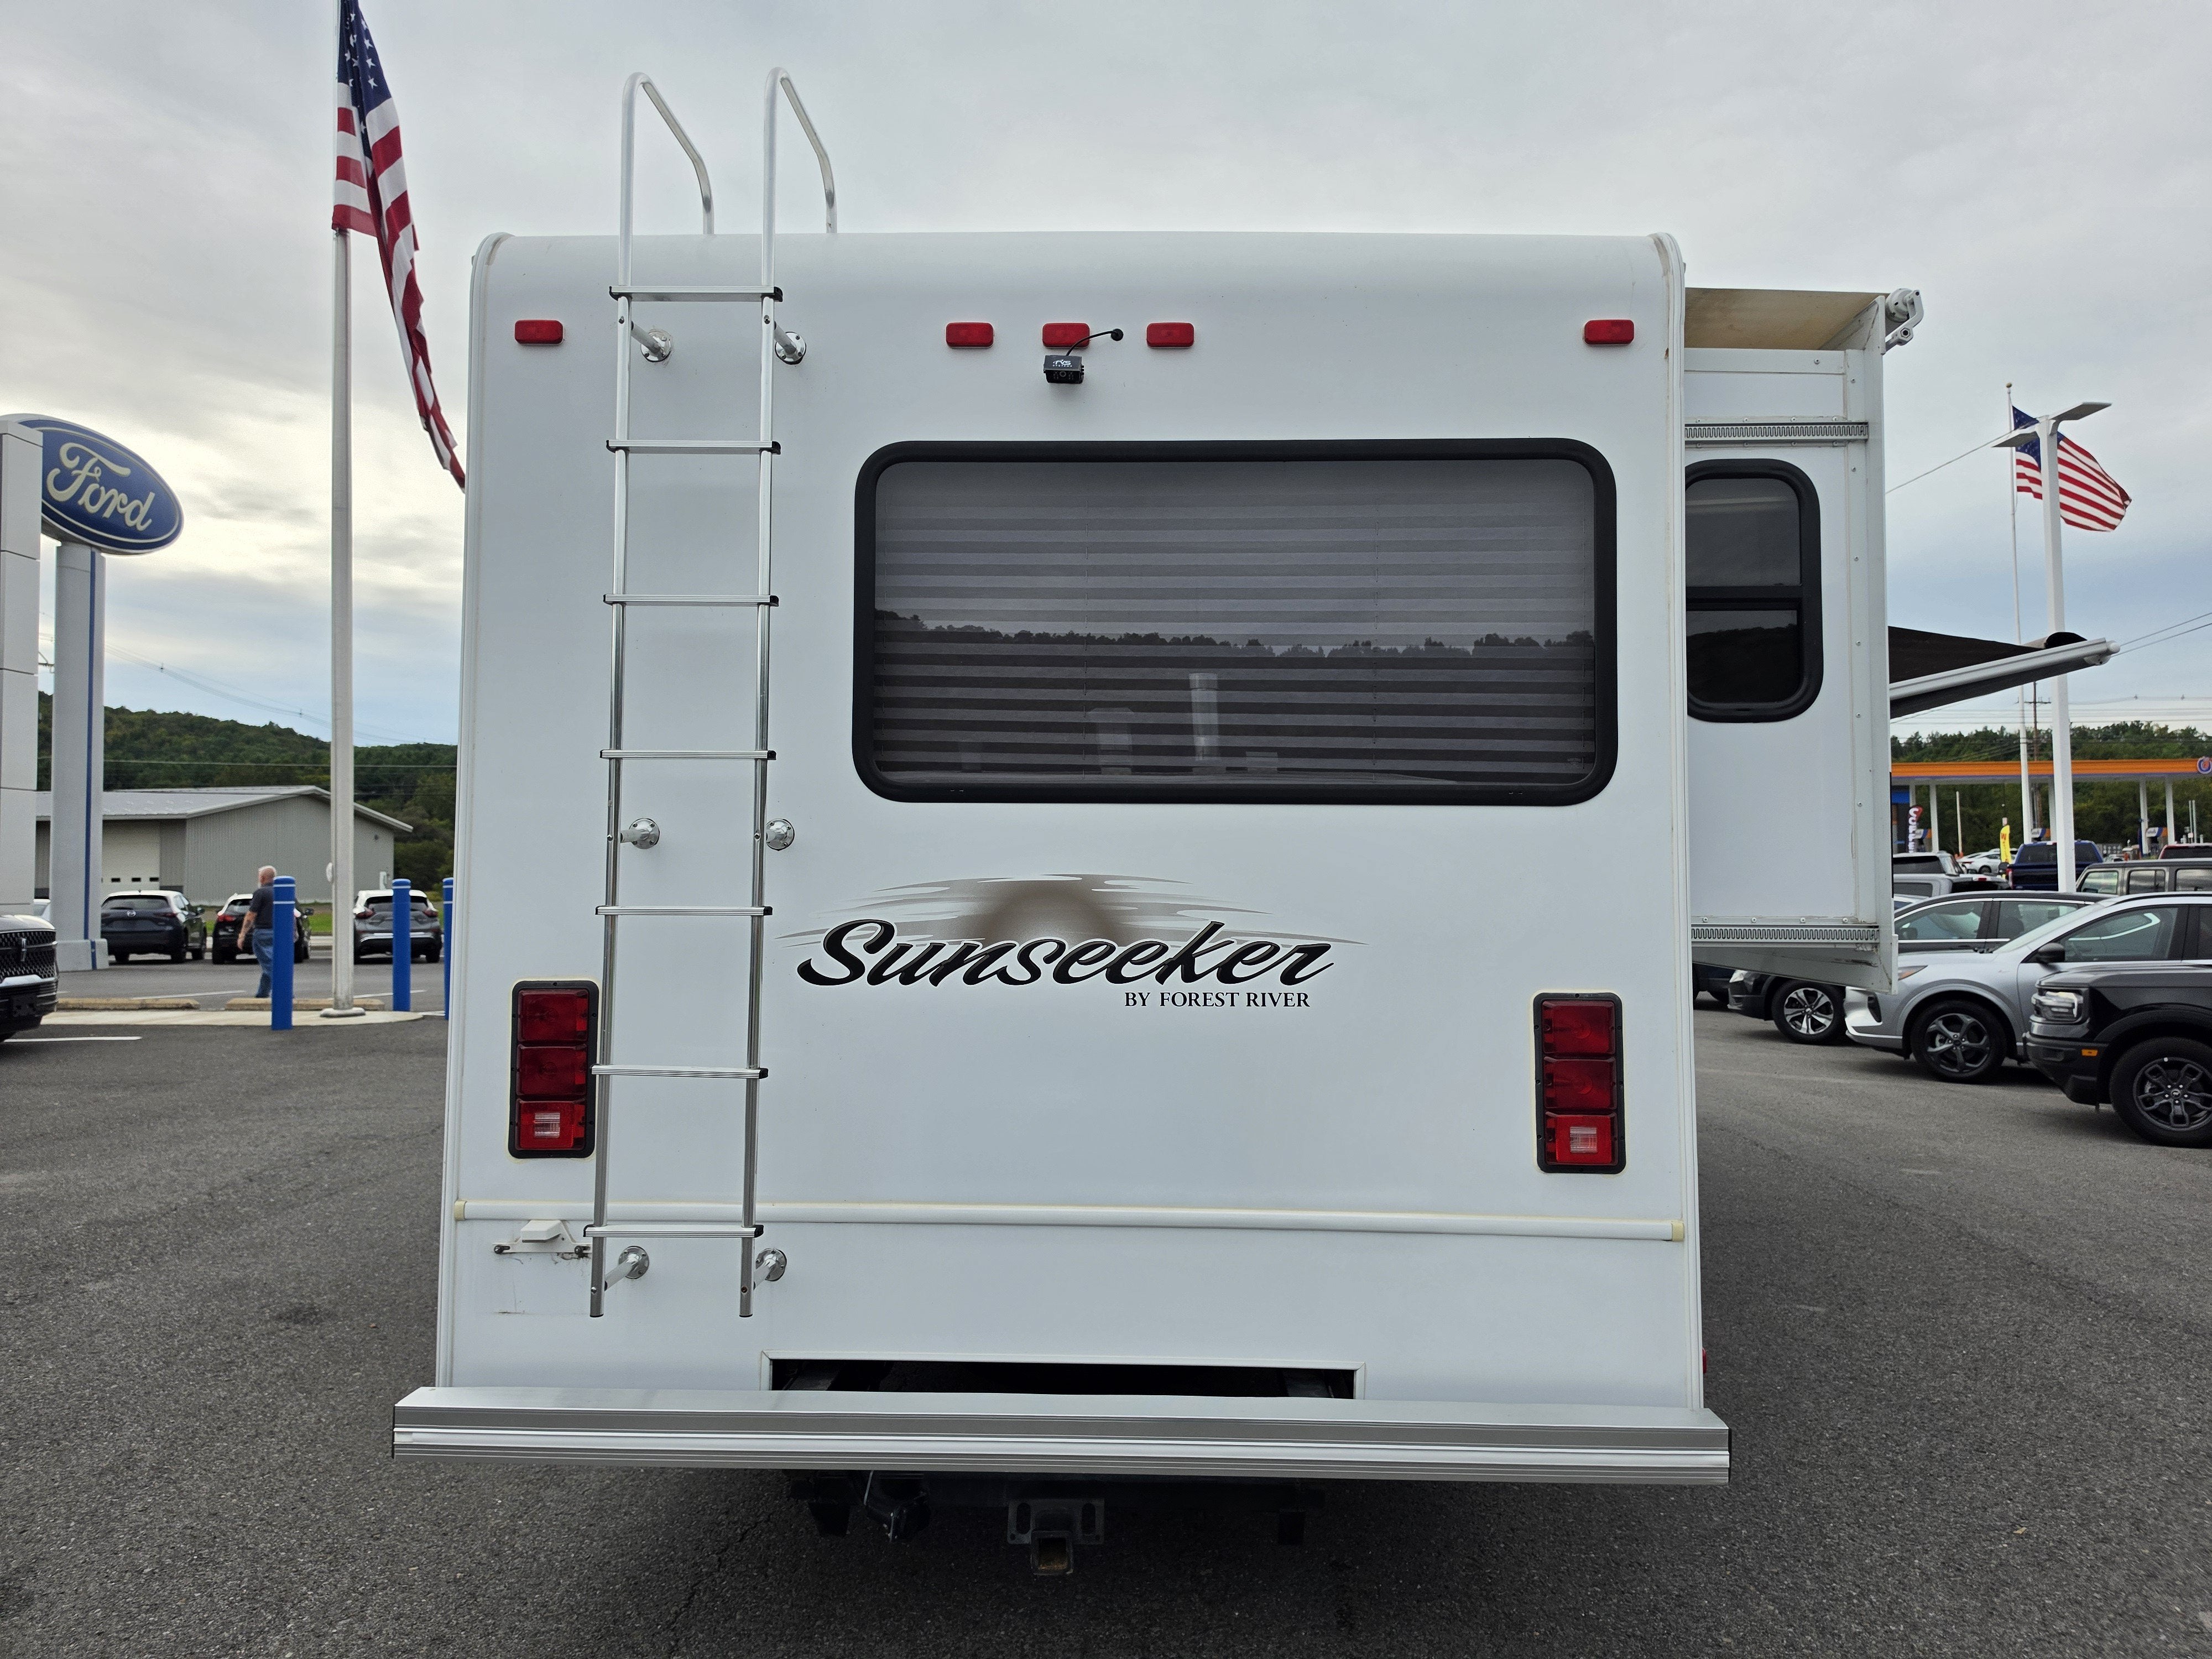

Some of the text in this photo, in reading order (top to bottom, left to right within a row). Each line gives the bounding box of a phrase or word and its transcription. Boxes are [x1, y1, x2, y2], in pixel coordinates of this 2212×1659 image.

[46, 442, 155, 531] Ford
[797, 919, 1334, 987] Sunseeker
[1125, 992, 1310, 1007] BY FOREST RIVER
